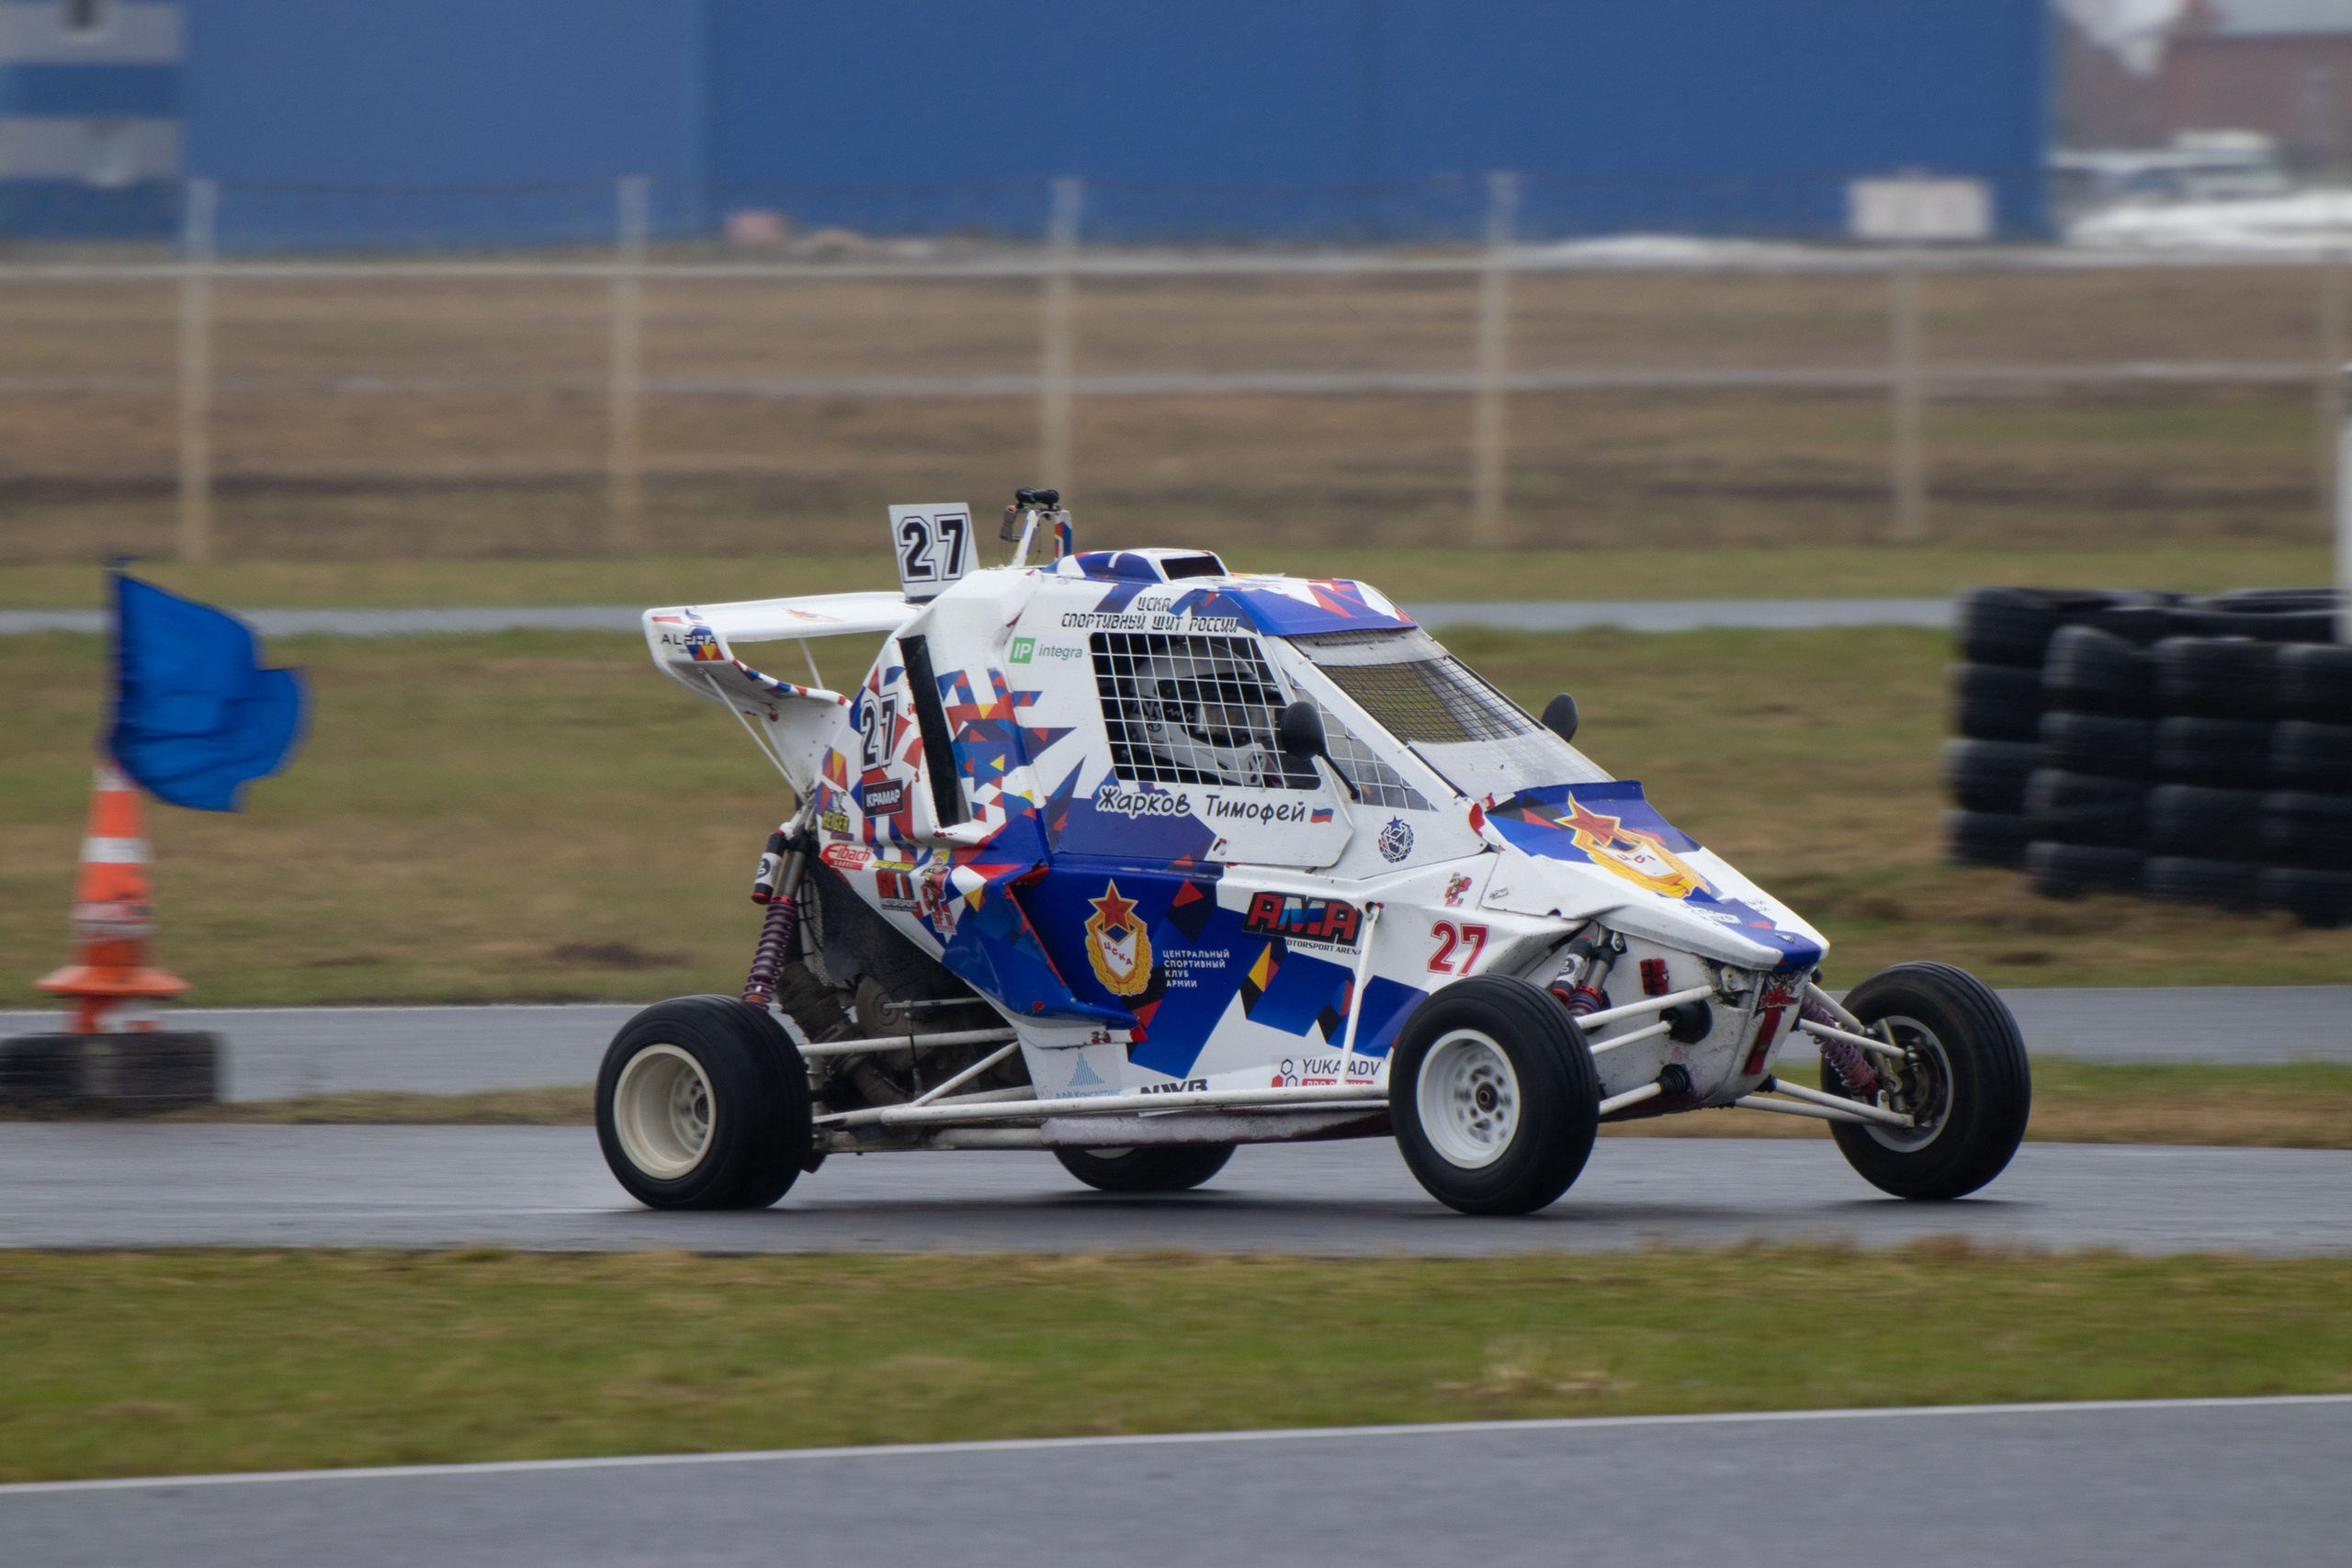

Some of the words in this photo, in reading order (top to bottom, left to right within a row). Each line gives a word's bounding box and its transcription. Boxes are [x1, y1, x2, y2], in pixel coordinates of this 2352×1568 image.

[898, 513, 968, 583] 27
[1061, 613, 1147, 630] СПОРТИВНЫЙ
[1189, 617, 1239, 633] РОССИИ
[661, 634, 718, 645] ALPHA
[1038, 644, 1083, 660] integra
[860, 692, 898, 774] 27
[866, 789, 900, 807] КРАМАР
[1099, 786, 1192, 818] Жарков
[1205, 794, 1306, 825] Тимофей
[820, 843, 871, 865] Eibach
[1243, 892, 1363, 947] AMA
[1103, 942, 1133, 965] ЦСКА
[1162, 949, 1230, 959] ЦЕНТРАЛЬНЫЙ
[1286, 938, 1334, 953] OTORSPORT
[1427, 919, 1489, 976] 27
[1163, 959, 1226, 968] СПОРТИВНЫЙ
[1165, 970, 1189, 978] КЛУБ
[1166, 979, 1198, 988] АРМИИ
